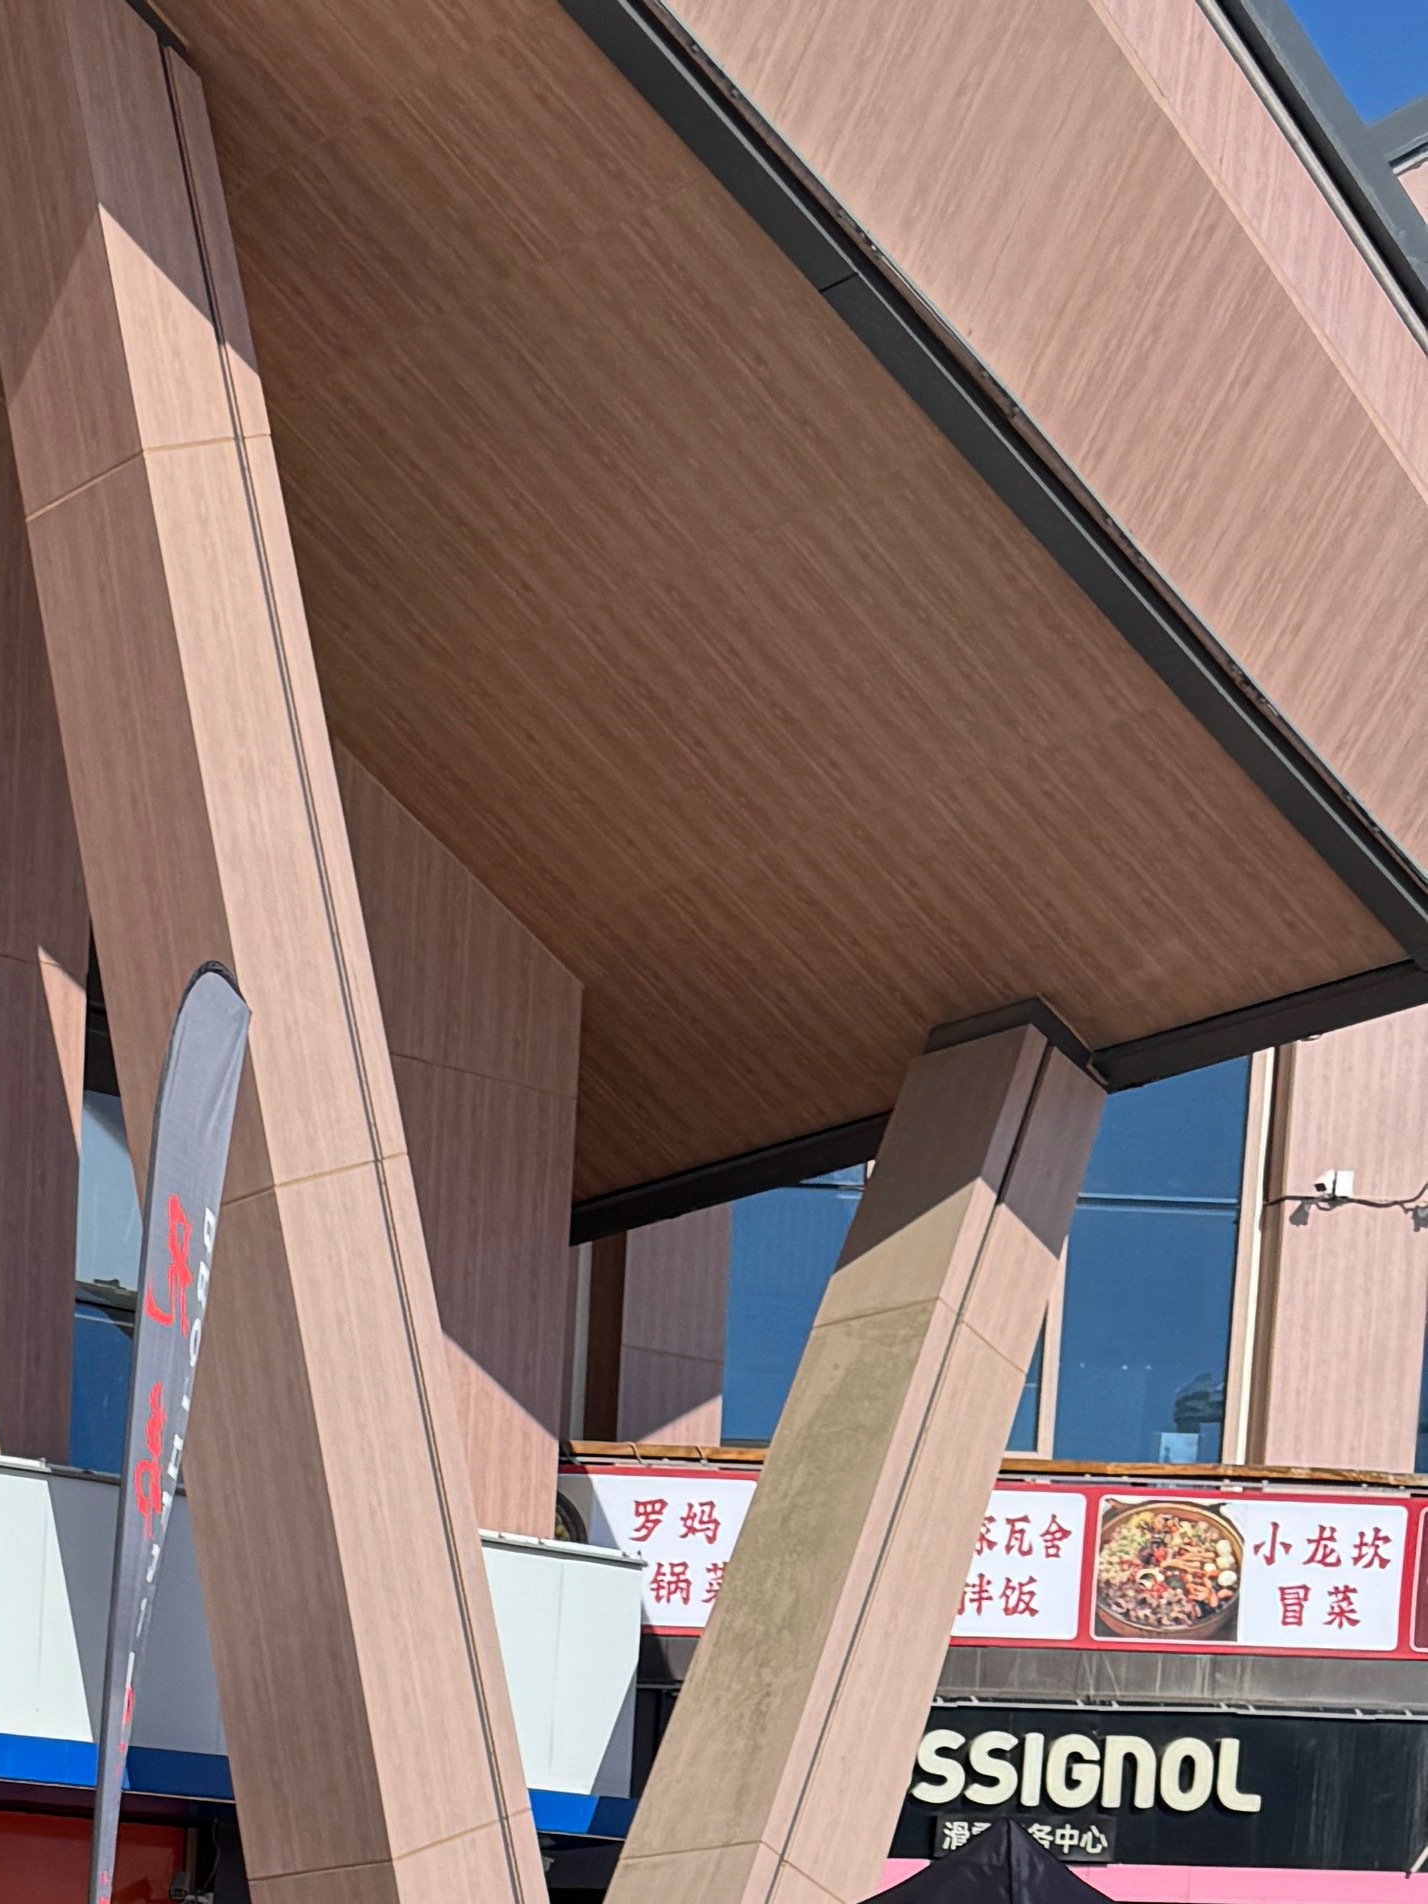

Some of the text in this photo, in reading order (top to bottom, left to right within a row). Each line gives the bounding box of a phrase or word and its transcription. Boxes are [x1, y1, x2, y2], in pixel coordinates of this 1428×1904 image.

[1252, 1520, 1393, 1571] 小龙坎
[1279, 1584, 1364, 1632] 冒菜
